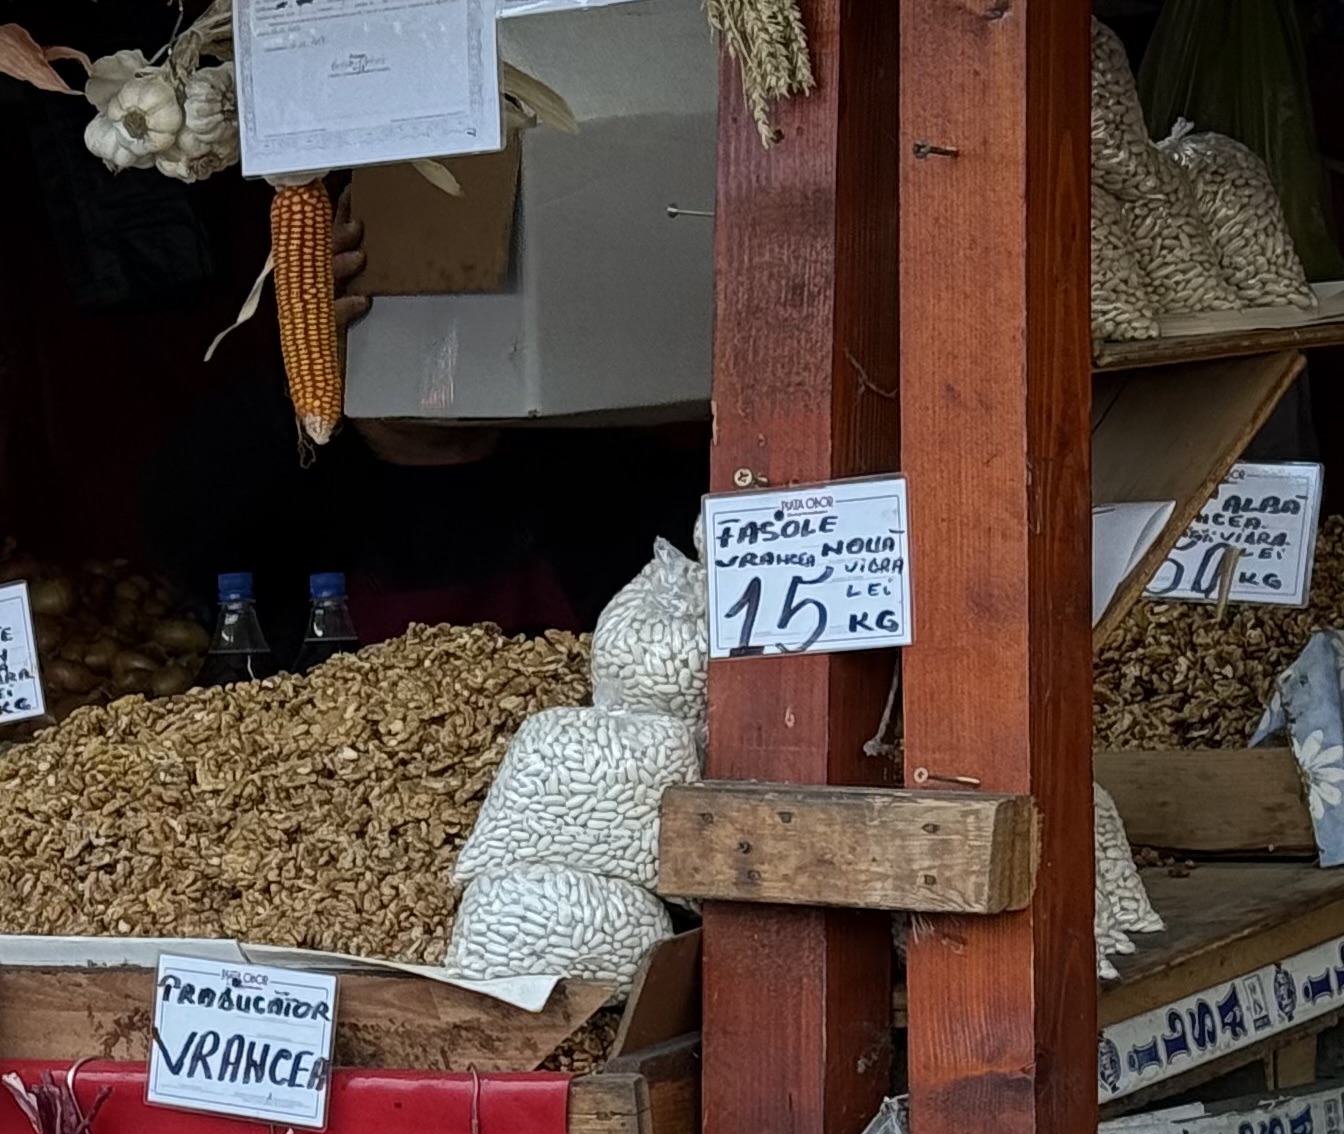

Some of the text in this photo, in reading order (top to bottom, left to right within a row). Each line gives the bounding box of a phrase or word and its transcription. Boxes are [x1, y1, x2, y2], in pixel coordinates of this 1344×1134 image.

[1238, 572, 1282, 590] KG
[724, 566, 835, 657] 15
[848, 610, 900, 633] KG
[152, 1026, 331, 1092] VRANCEA
